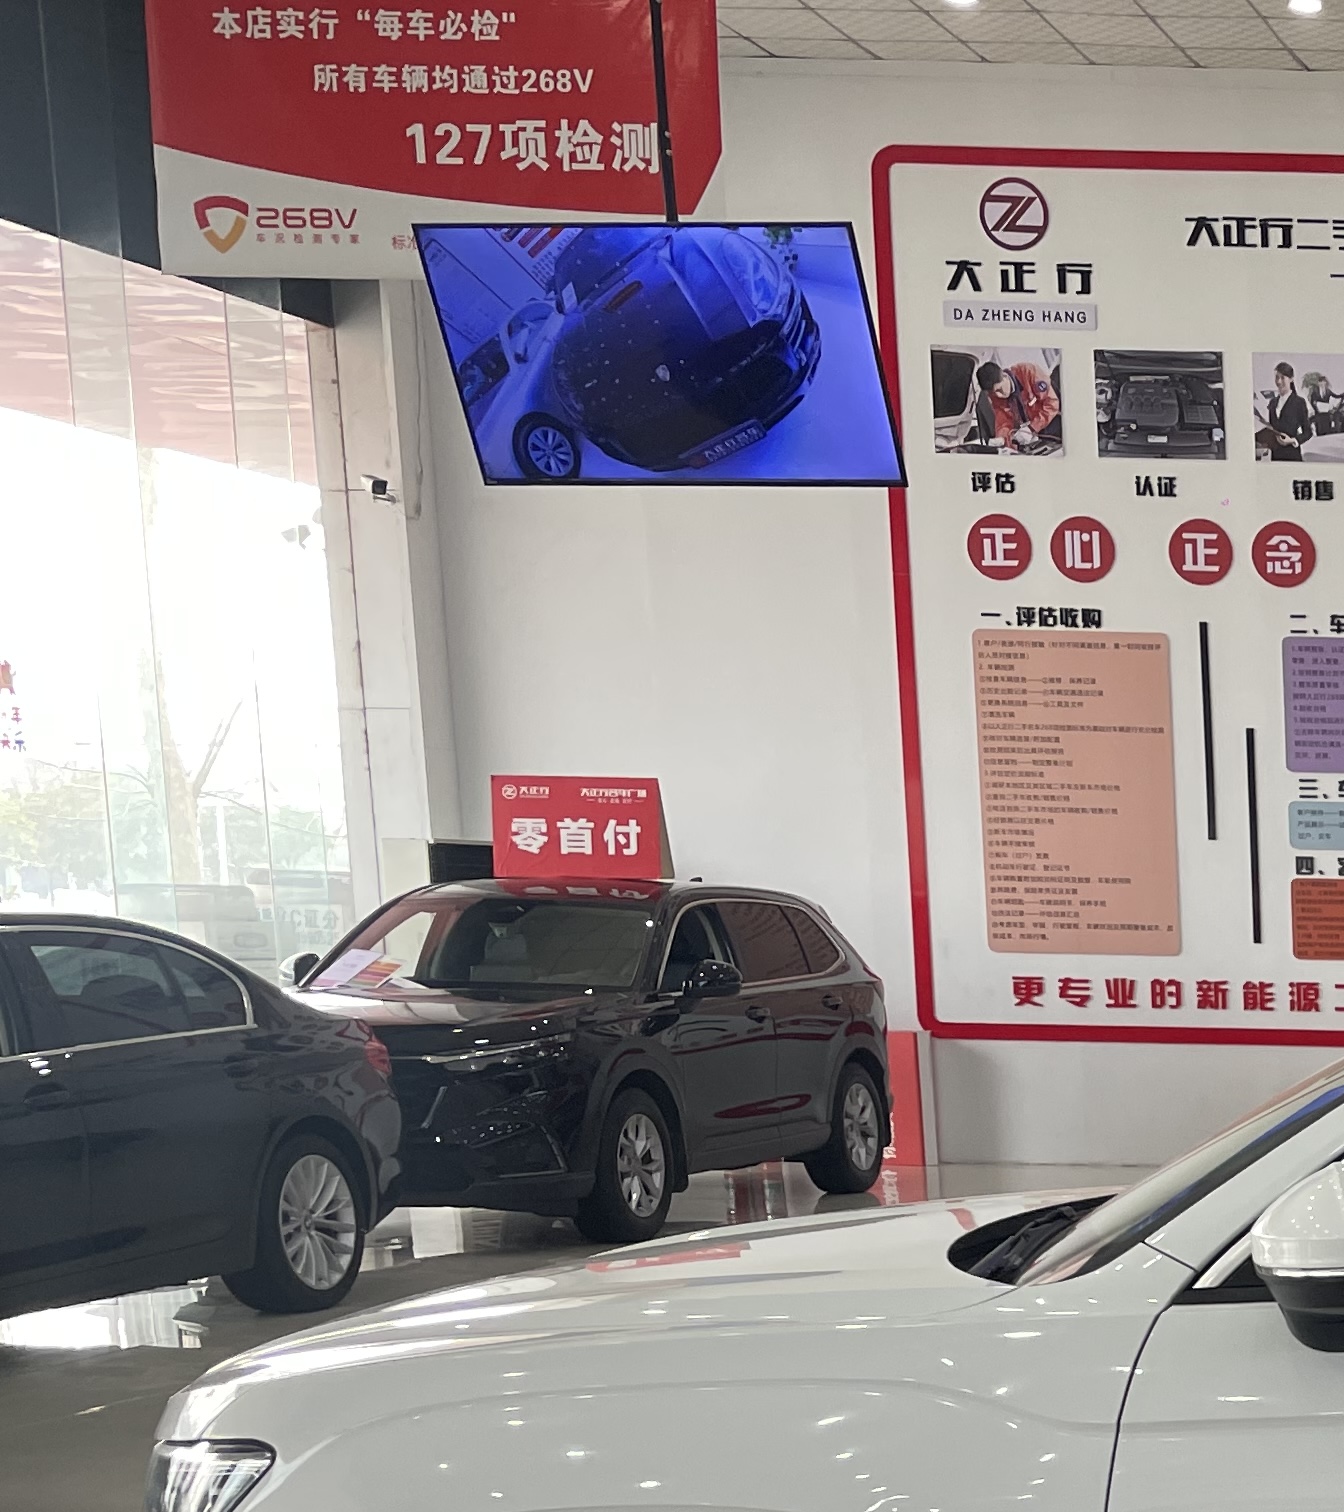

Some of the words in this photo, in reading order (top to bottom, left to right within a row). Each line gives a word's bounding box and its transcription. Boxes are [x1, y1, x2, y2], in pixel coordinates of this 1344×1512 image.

[212, 8, 339, 40] 本店实行
[313, 63, 595, 95] 所有车辆均通过268V
[405, 118, 662, 174] 127项检测
[255, 207, 357, 229] 268V
[944, 259, 1093, 295] 大正行
[952, 308, 975, 321] DA
[981, 309, 1035, 322] ZHENG
[1041, 311, 1088, 324] HANG
[971, 472, 1016, 494] 评估
[1135, 476, 1178, 498] 认证
[1292, 480, 1335, 502] 销售
[510, 817, 642, 856] 零首付
